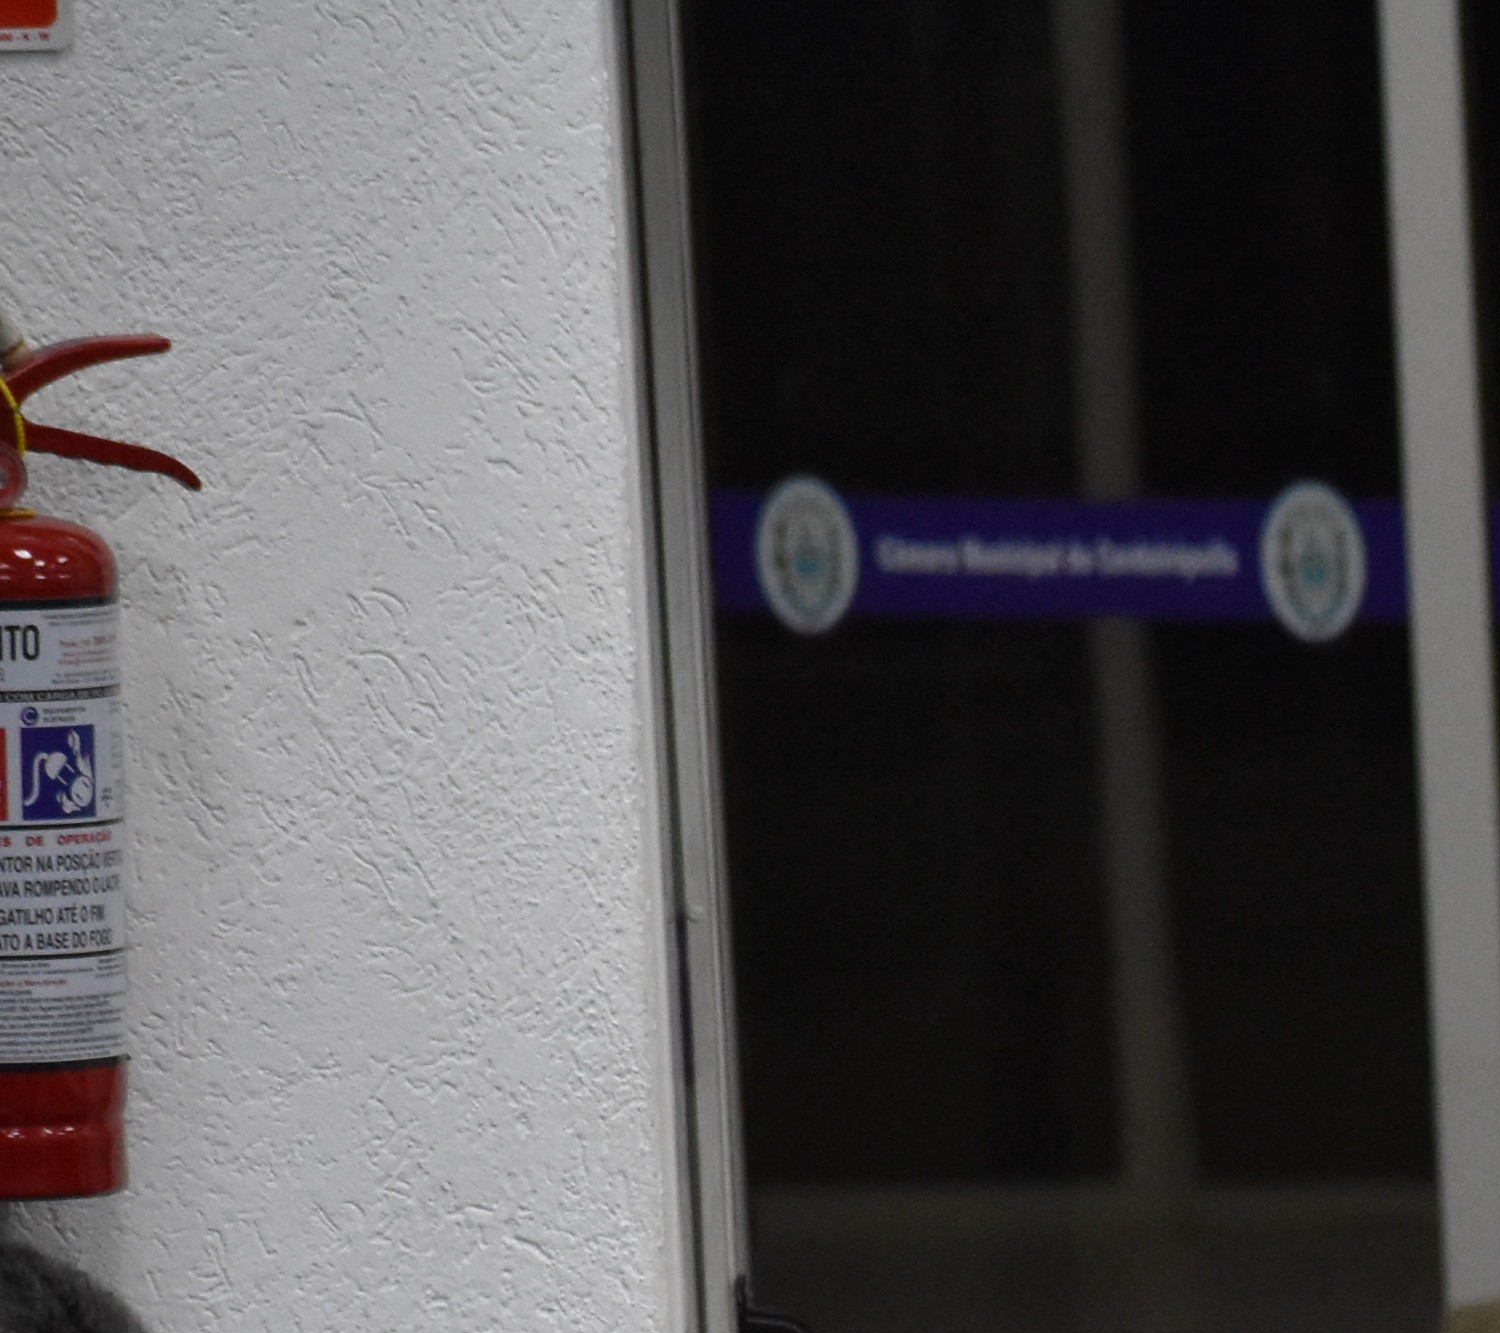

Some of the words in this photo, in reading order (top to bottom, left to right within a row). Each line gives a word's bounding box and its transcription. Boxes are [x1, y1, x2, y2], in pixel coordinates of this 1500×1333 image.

[0, 624, 40, 661] TO
[36, 855, 54, 872] NA
[0, 933, 20, 951] TO
[36, 931, 70, 950] BASE
